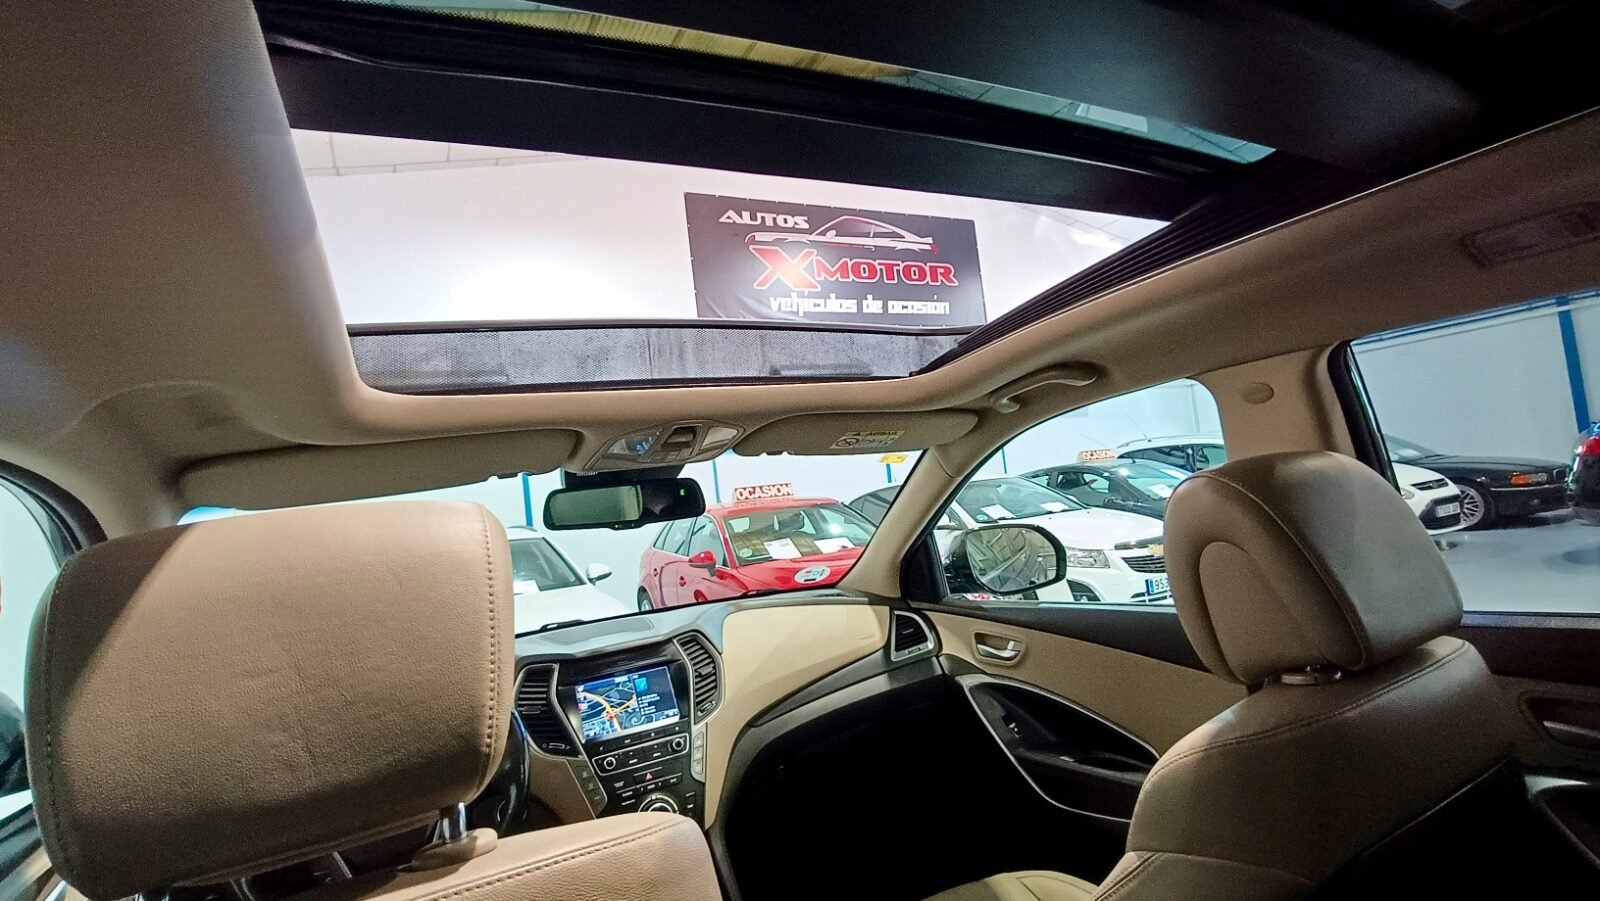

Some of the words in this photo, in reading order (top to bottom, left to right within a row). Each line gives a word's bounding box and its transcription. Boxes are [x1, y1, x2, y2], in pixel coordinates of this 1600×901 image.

[718, 209, 811, 228] AUTOS
[862, 294, 883, 313] de
[735, 483, 793, 500] OCASION
